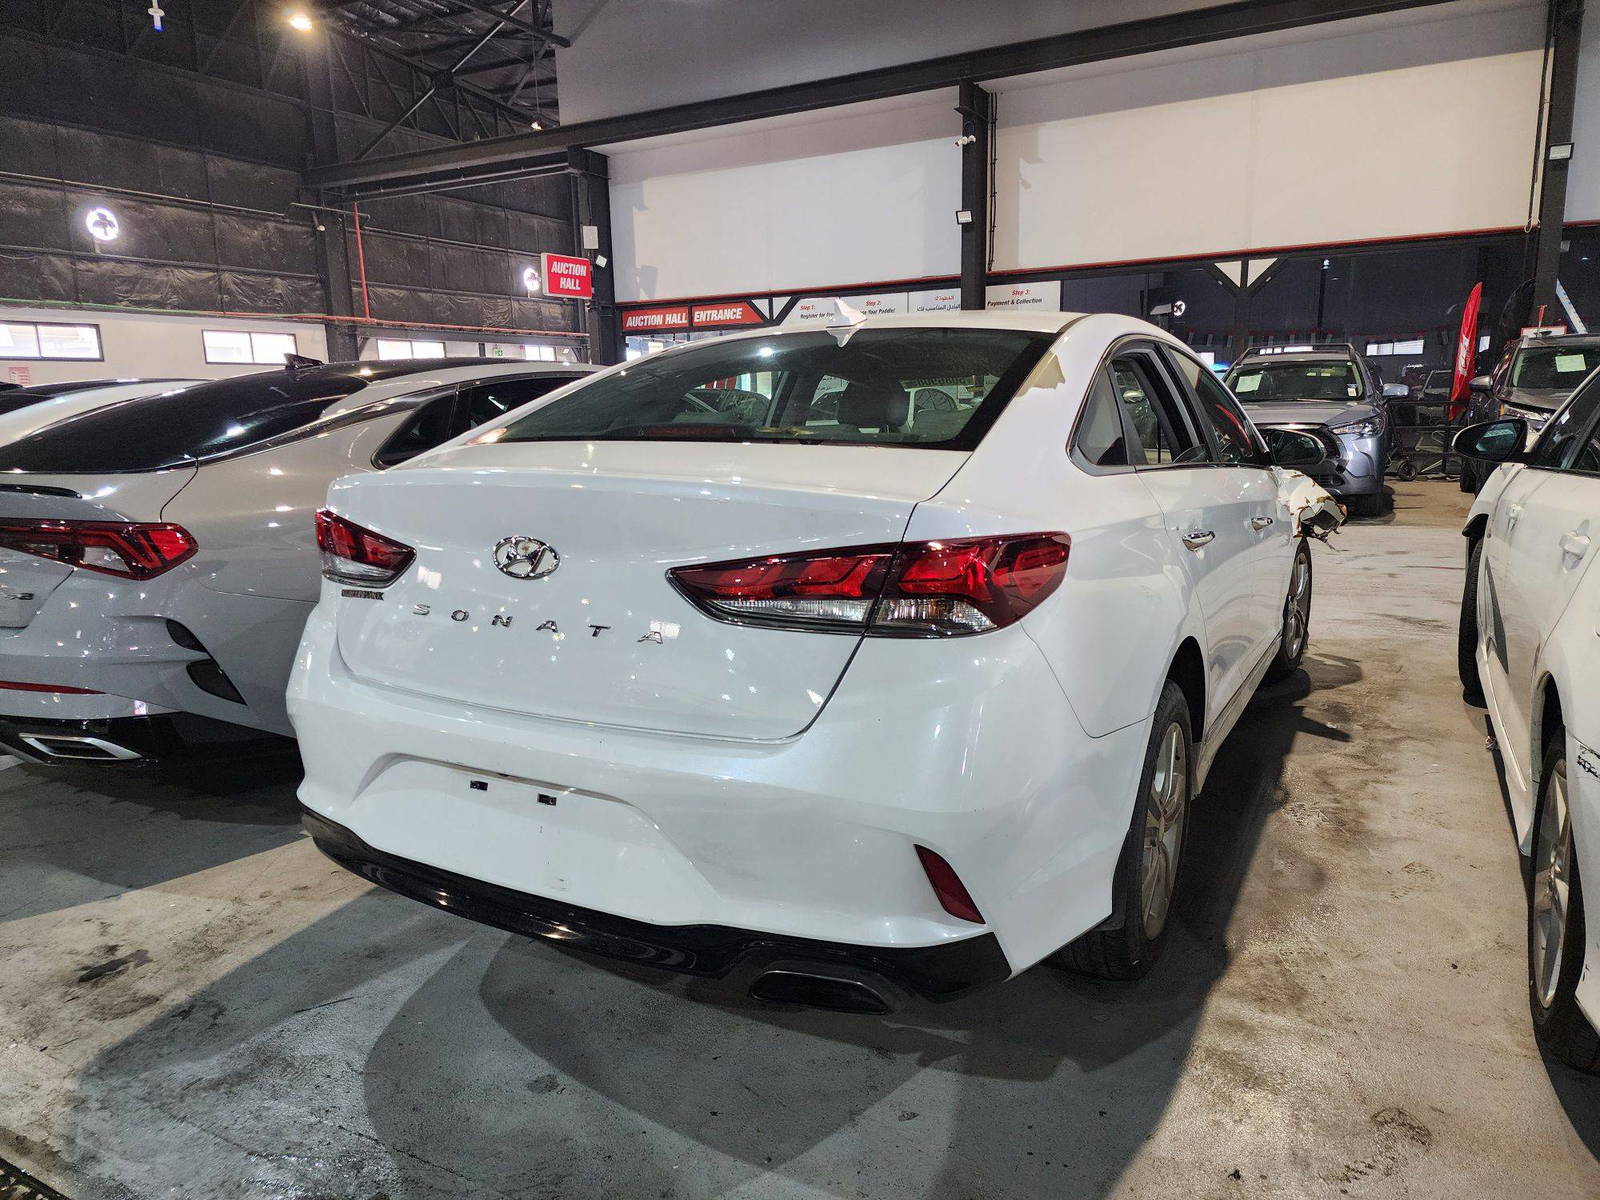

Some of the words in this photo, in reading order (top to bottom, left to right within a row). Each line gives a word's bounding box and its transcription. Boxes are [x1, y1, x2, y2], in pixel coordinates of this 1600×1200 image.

[551, 261, 587, 277] AUCTION
[560, 277, 581, 290] HALL
[626, 315, 663, 327] AUCTION
[665, 312, 688, 325] HALL
[694, 308, 743, 322] ENTRANCE
[413, 603, 663, 645] SONATA
